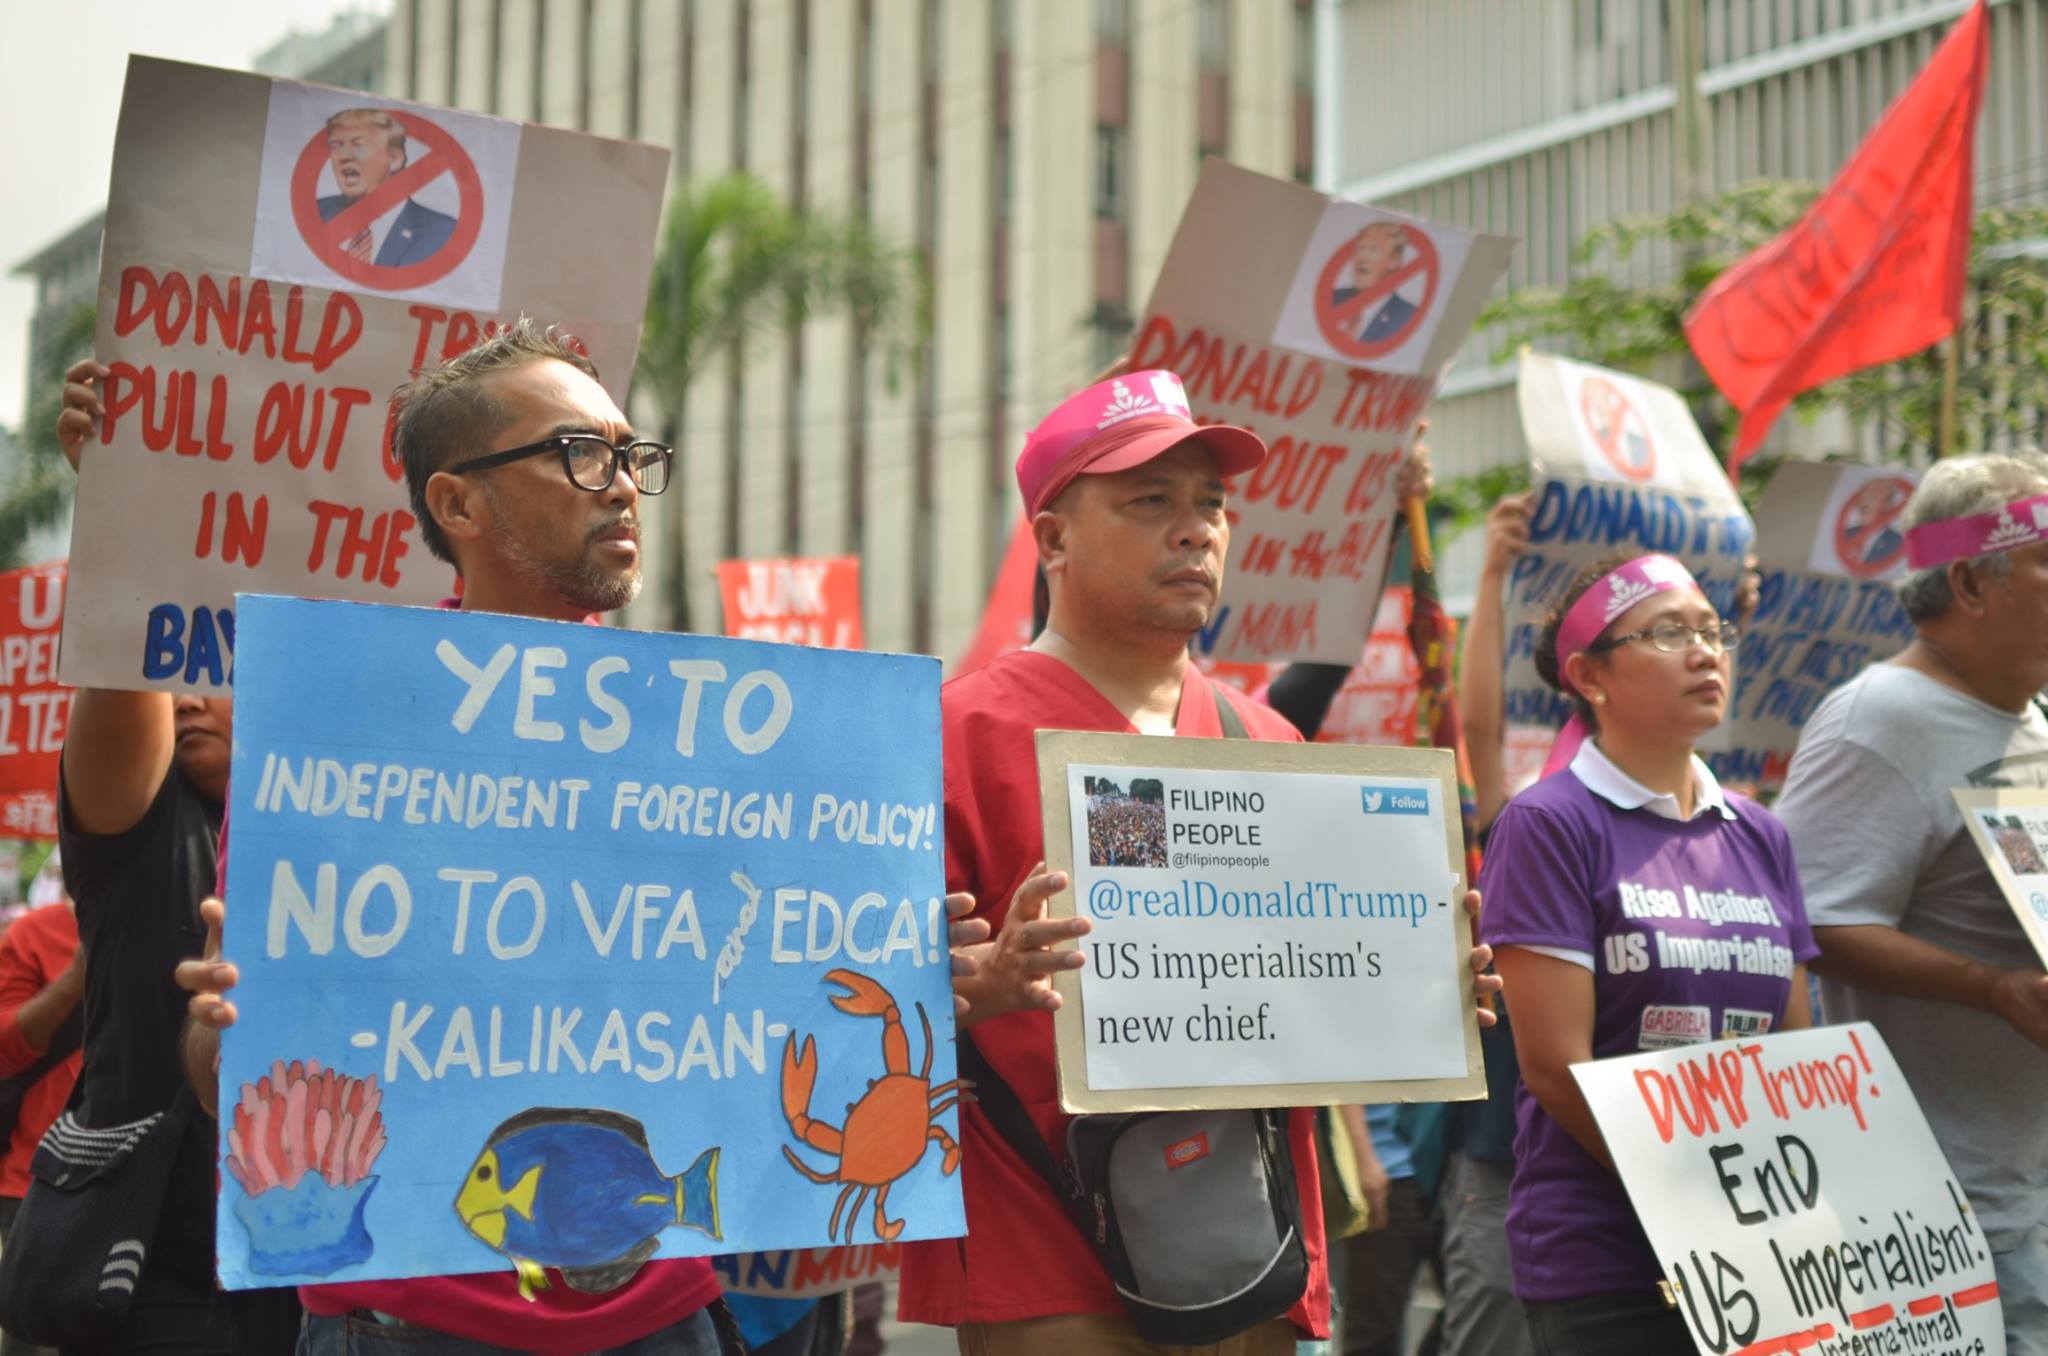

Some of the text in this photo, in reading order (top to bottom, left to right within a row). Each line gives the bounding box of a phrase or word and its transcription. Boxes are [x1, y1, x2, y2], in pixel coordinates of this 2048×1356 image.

[114, 265, 364, 374] DONALD
[1128, 316, 1324, 419] DONALD
[102, 361, 230, 462] PULL
[253, 380, 372, 472] OUT
[1243, 434, 1348, 513] OUT
[195, 491, 416, 589] IN THE
[1240, 532, 1286, 577] IN
[19, 575, 62, 631] U
[736, 564, 829, 620] JUNK
[436, 638, 793, 758] YES TO
[255, 752, 938, 851] INDEPENDENT FOREIGN POLICY!
[1170, 788, 1428, 814] FILIPINO Follow
[1171, 852, 1270, 870] @filipinopeople
[1172, 823, 1262, 847] PEOPLE
[265, 860, 413, 960] NO
[437, 867, 547, 960] TO
[571, 877, 709, 962] VFA
[769, 888, 942, 969] EDCA!
[1088, 879, 1428, 928] @realDonaldTrump
[1618, 881, 1782, 928] Rise Against
[1091, 941, 1383, 990] US imperialism's
[1604, 931, 1650, 975] US
[350, 1000, 788, 1084] -KALIKASAN-
[1097, 1003, 1277, 1044] new chief.
[1643, 1008, 1707, 1035] GABRIELA
[1633, 1030, 1881, 1144] DUMP Trump!
[1709, 1134, 1820, 1227] EnD
[1673, 1179, 1987, 1356] US Imperialism!
